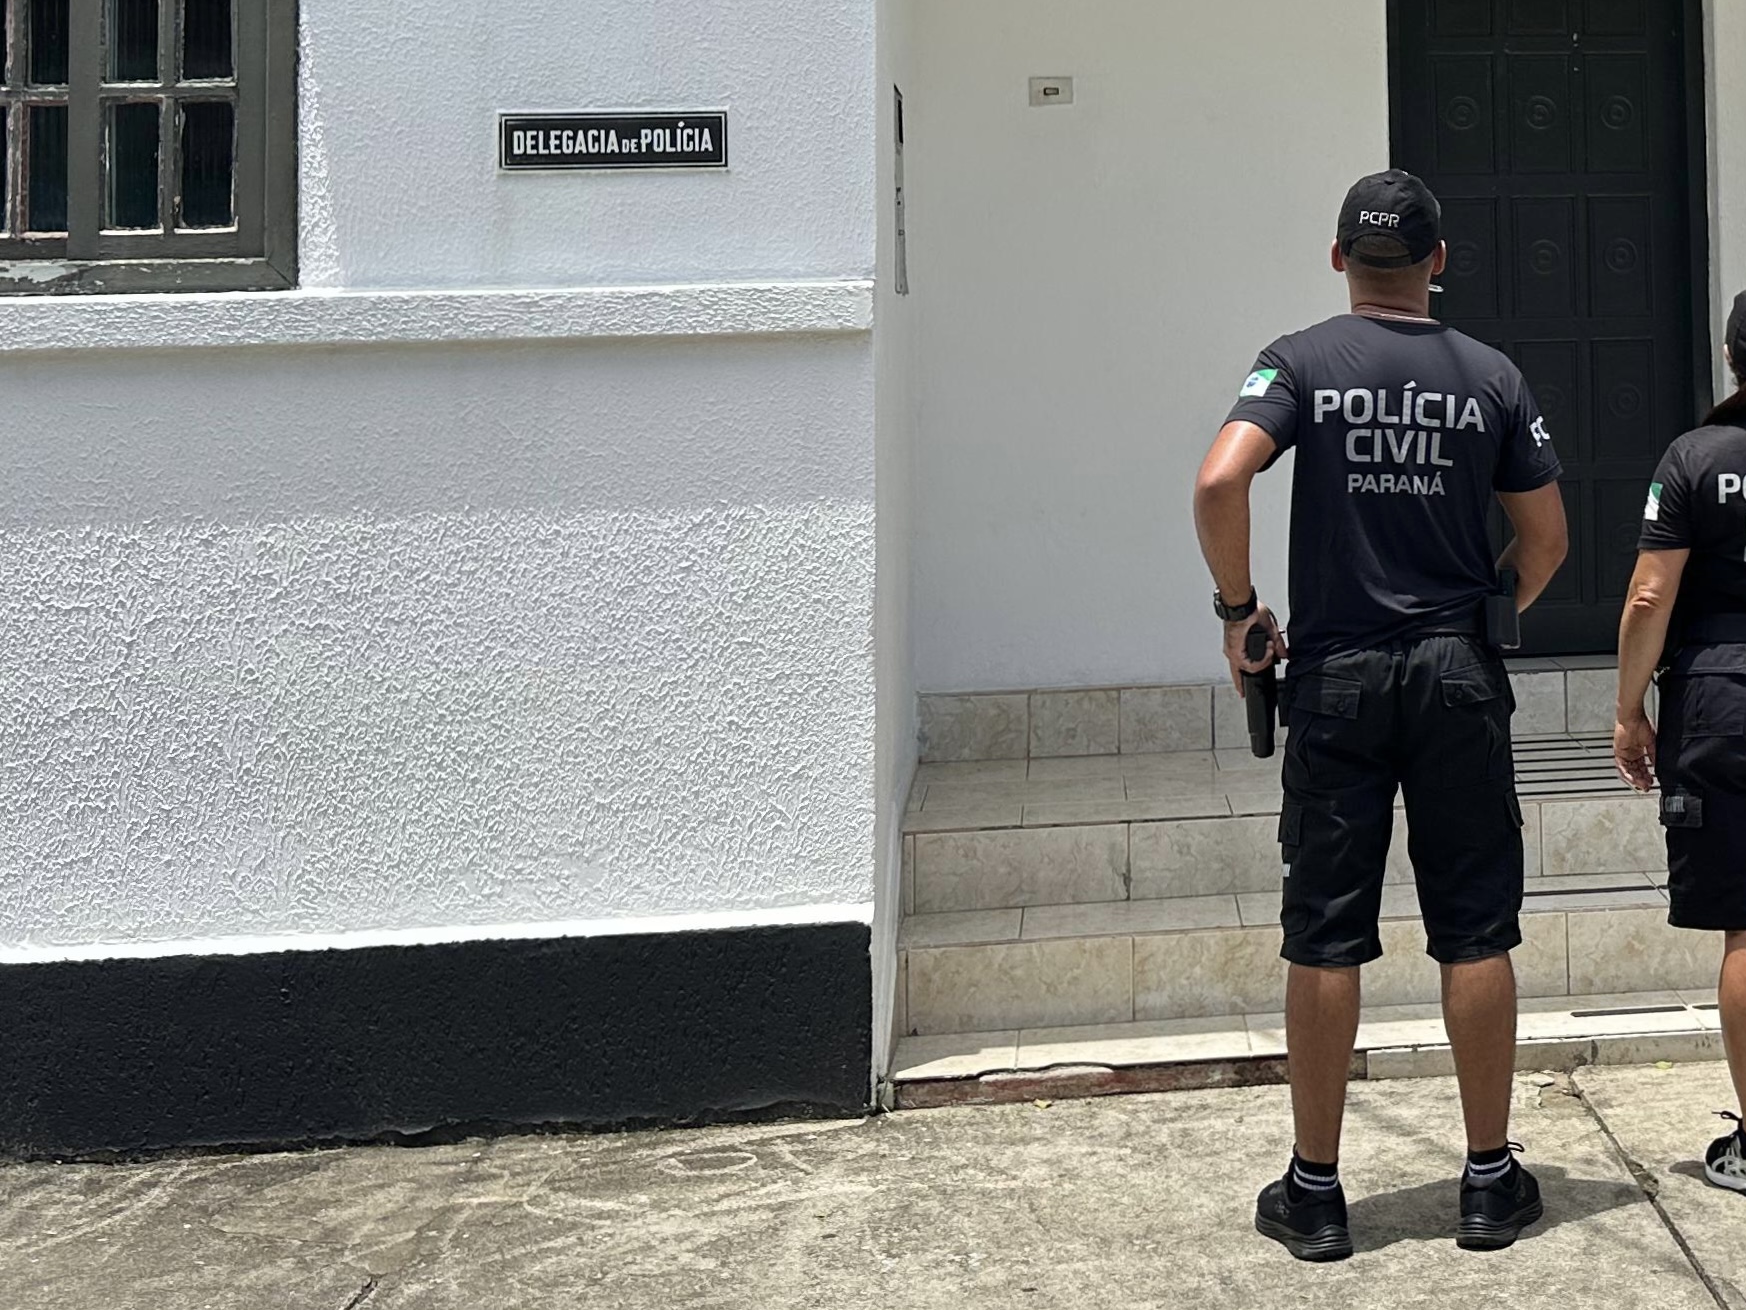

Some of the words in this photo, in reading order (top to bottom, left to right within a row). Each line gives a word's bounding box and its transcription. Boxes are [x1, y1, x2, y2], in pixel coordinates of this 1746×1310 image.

[512, 128, 620, 156] DELEGACIA
[621, 137, 640, 154] DE
[640, 120, 715, 153] POLÍCIA
[1358, 210, 1400, 228] PCPR
[1313, 380, 1486, 433] POLÍCIA
[1345, 428, 1454, 467] CIVIL
[1347, 471, 1446, 496] PARANÁ
